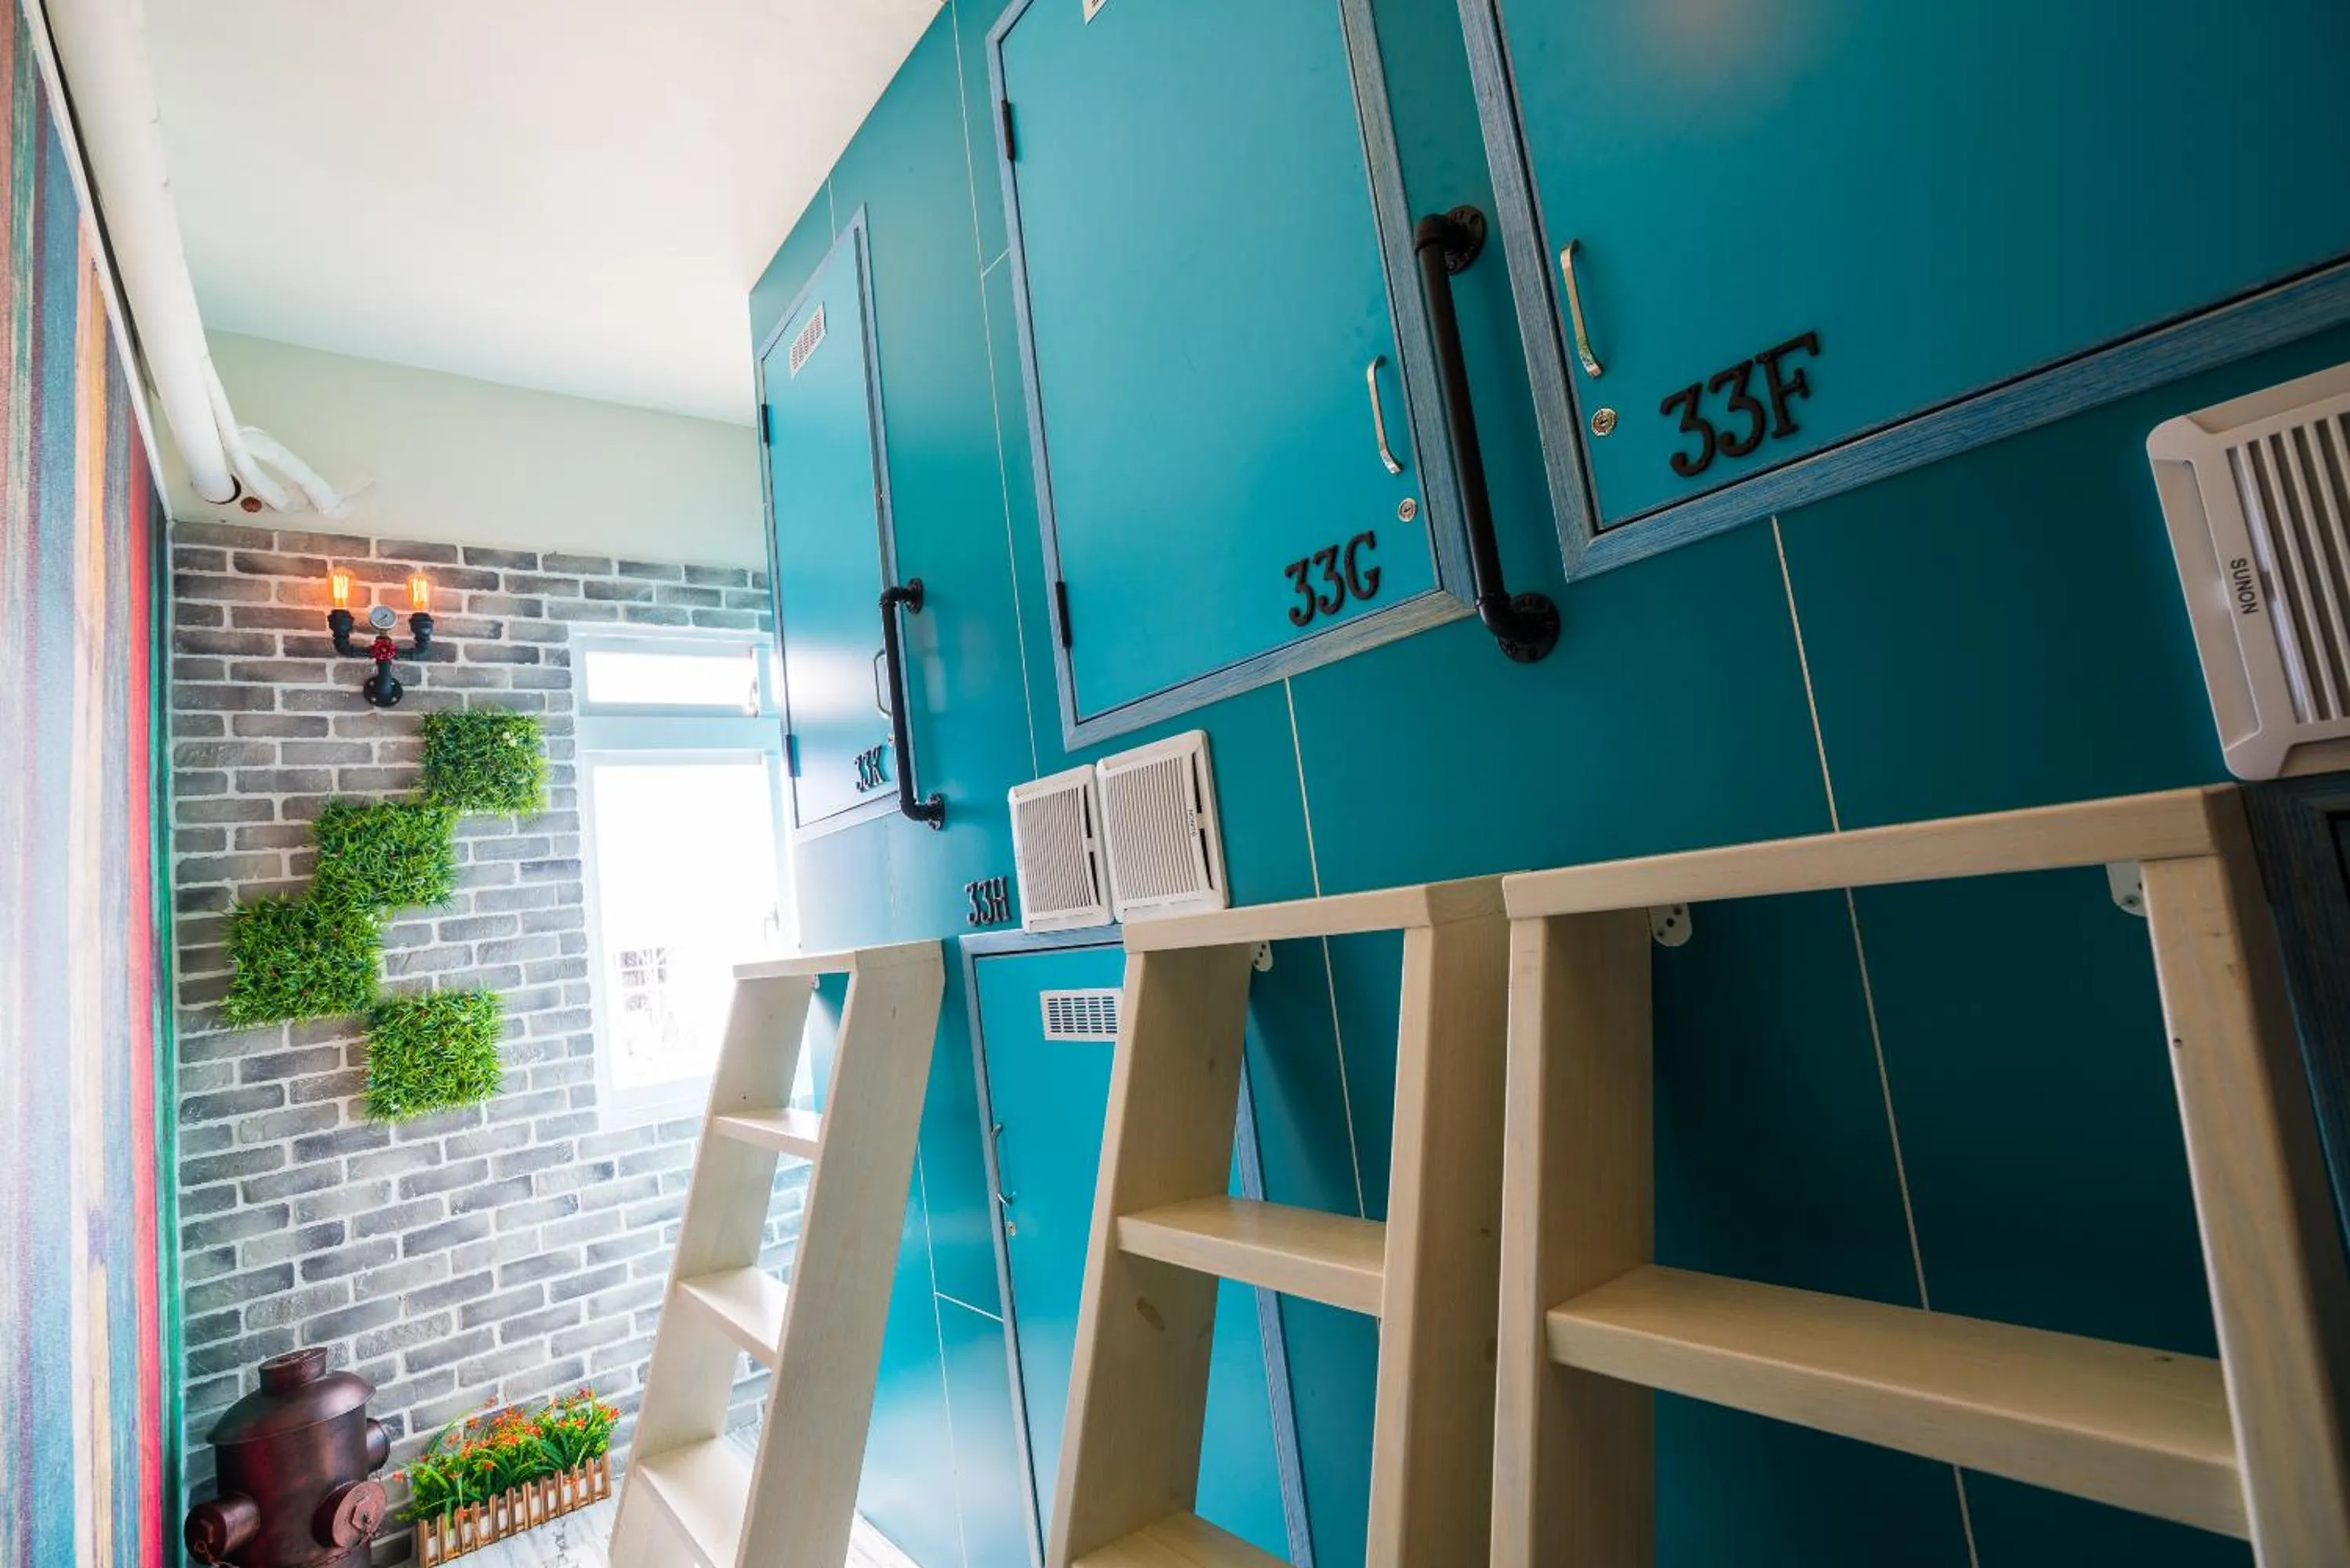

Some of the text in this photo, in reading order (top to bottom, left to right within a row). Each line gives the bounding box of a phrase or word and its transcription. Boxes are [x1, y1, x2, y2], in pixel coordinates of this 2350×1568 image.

[1659, 330, 1820, 477] 33F
[1284, 530, 1381, 626] 33G
[2230, 557, 2259, 615] SUNON
[853, 744, 890, 793] 33K
[964, 876, 1012, 927] 33H
